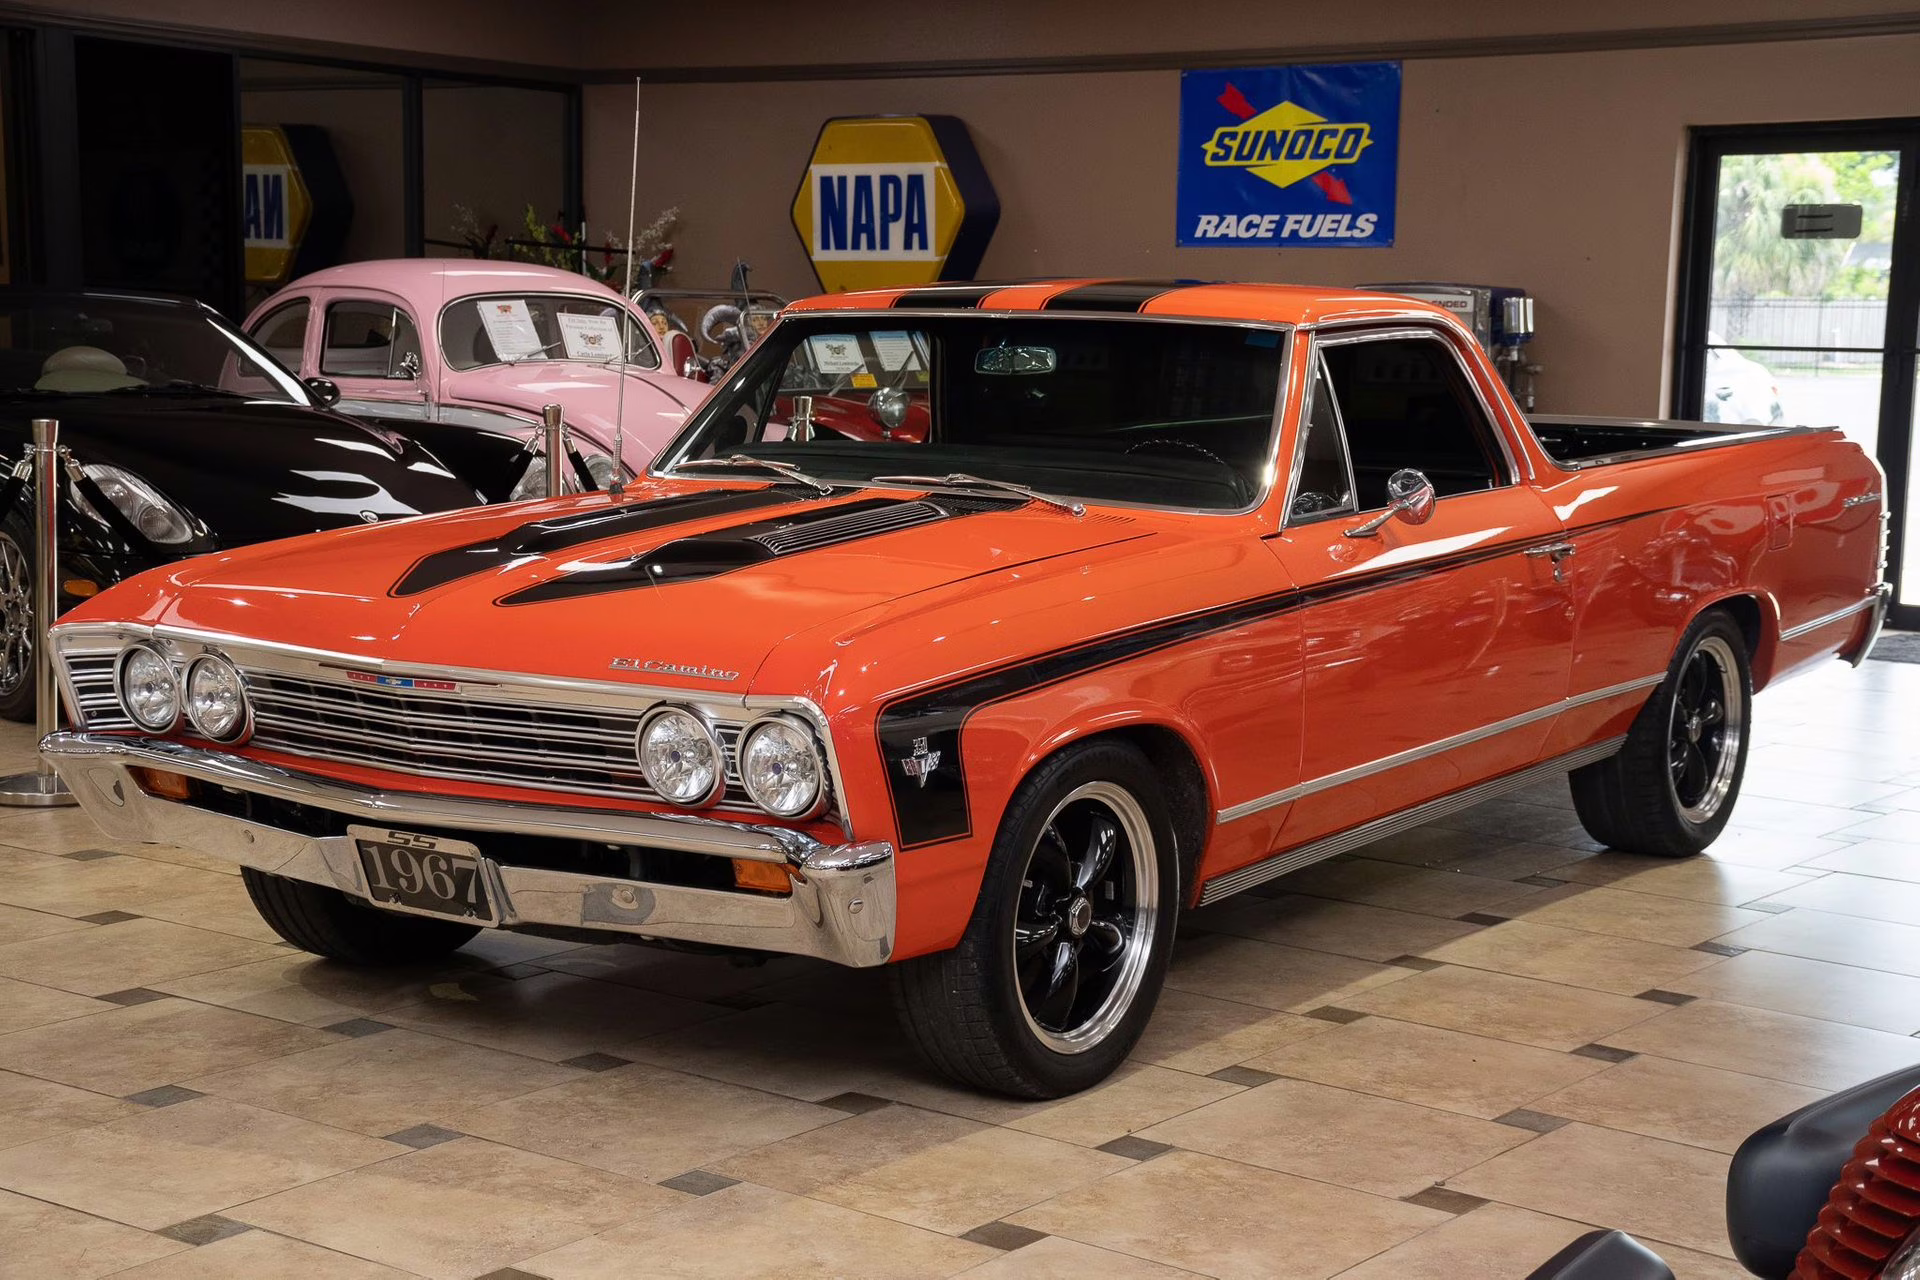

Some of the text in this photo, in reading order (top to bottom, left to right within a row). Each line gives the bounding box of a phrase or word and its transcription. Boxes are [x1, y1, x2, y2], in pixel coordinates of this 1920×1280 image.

[1209, 127, 1365, 162] SUNOCO
[819, 173, 929, 251] NAPA
[1194, 212, 1379, 239] RACE FUELS
[643, 659, 741, 681] Camino
[387, 830, 439, 849] SS
[362, 846, 478, 904] 1967
